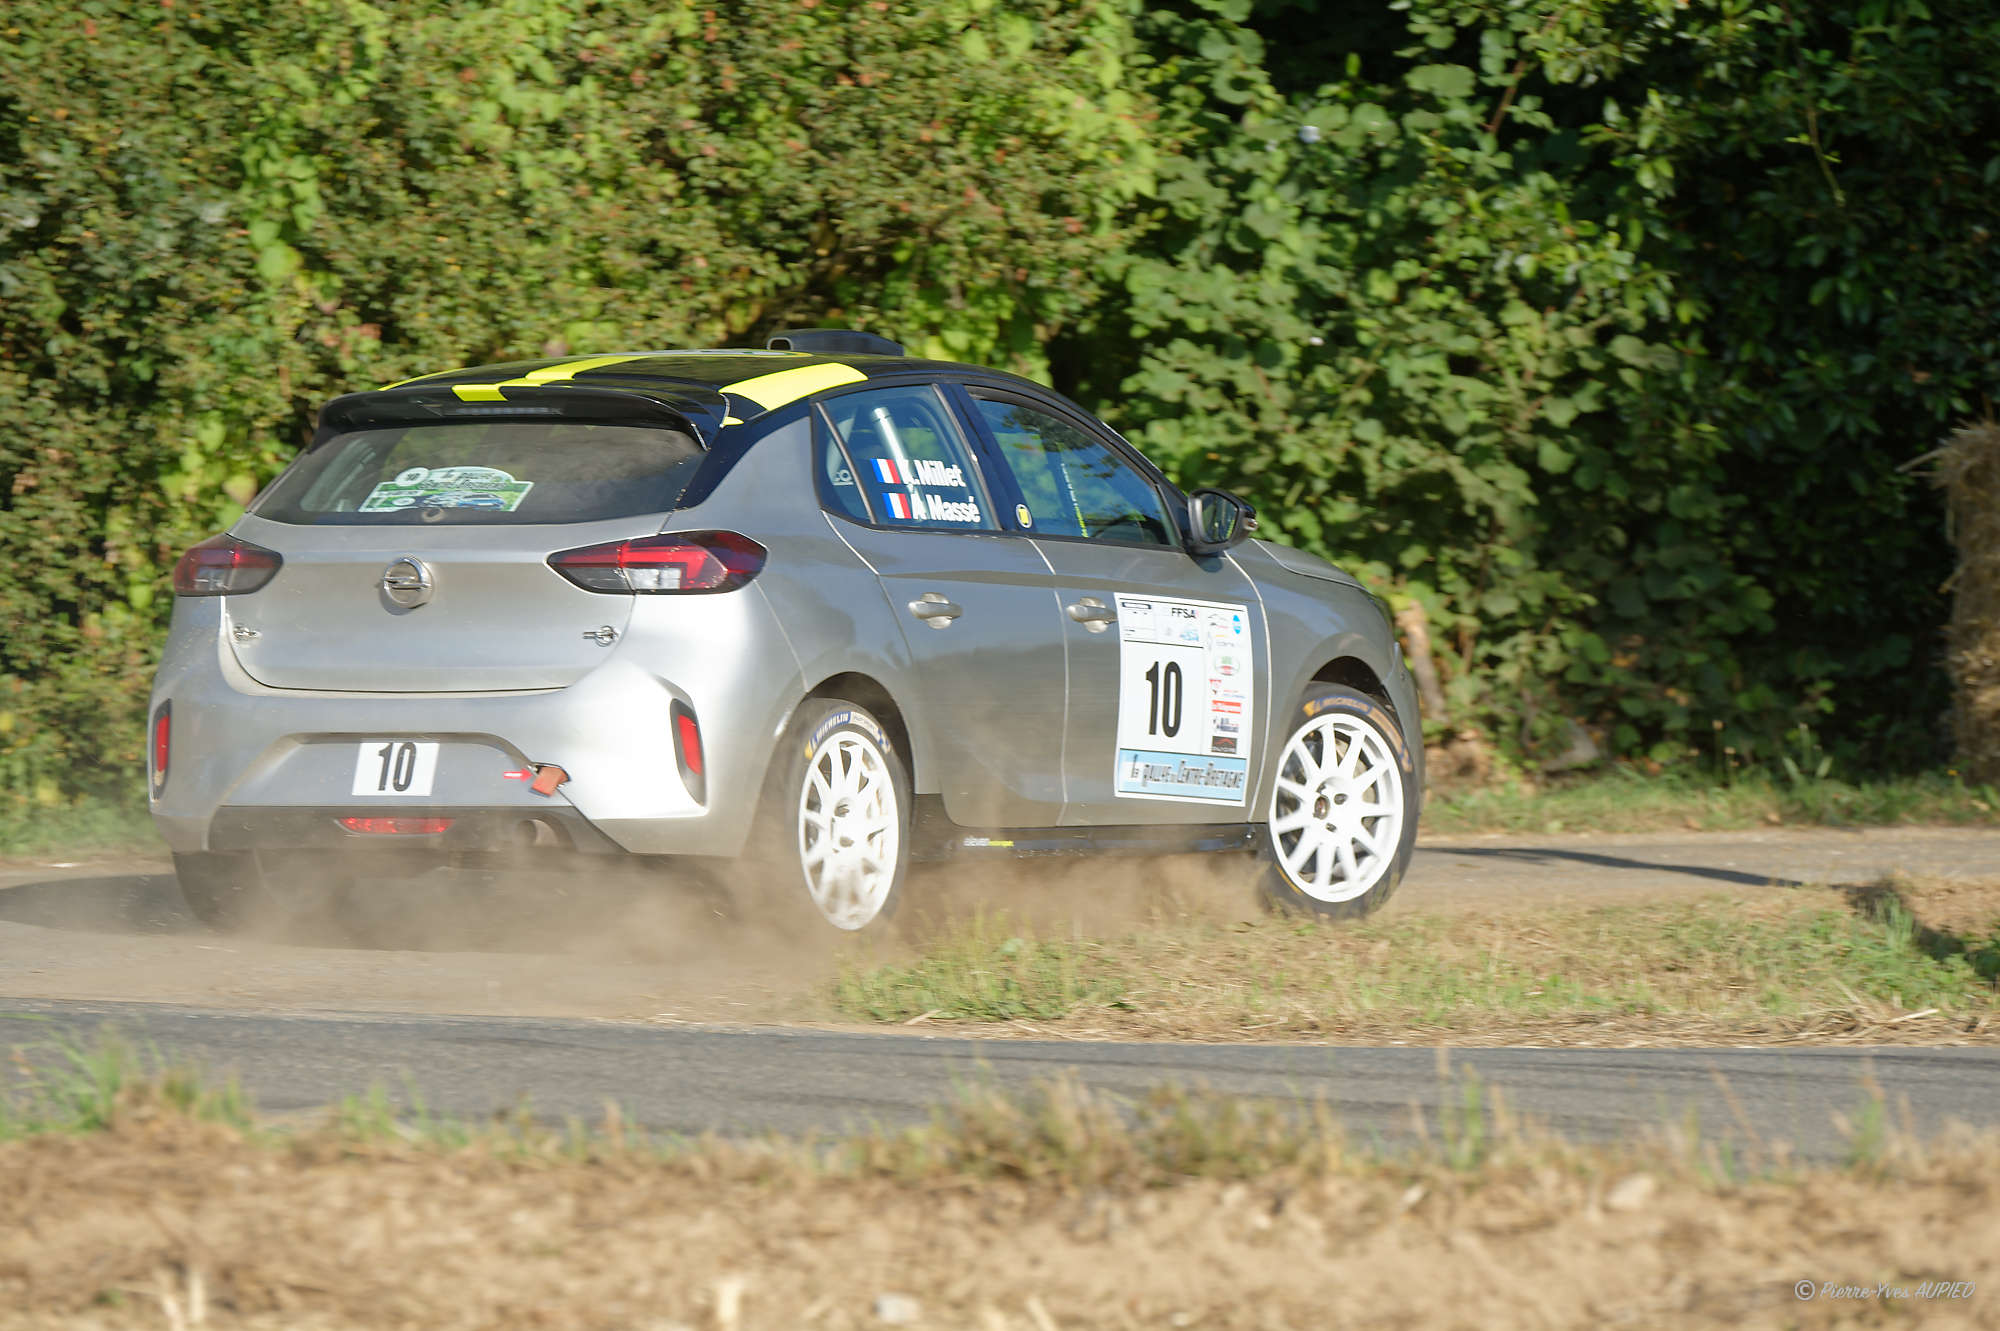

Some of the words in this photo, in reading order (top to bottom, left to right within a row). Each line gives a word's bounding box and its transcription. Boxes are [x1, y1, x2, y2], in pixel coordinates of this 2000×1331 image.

[925, 494, 981, 523] Massé
[1171, 607, 1197, 619] FFSA
[1145, 661, 1183, 738] 10
[377, 741, 417, 792] 10
